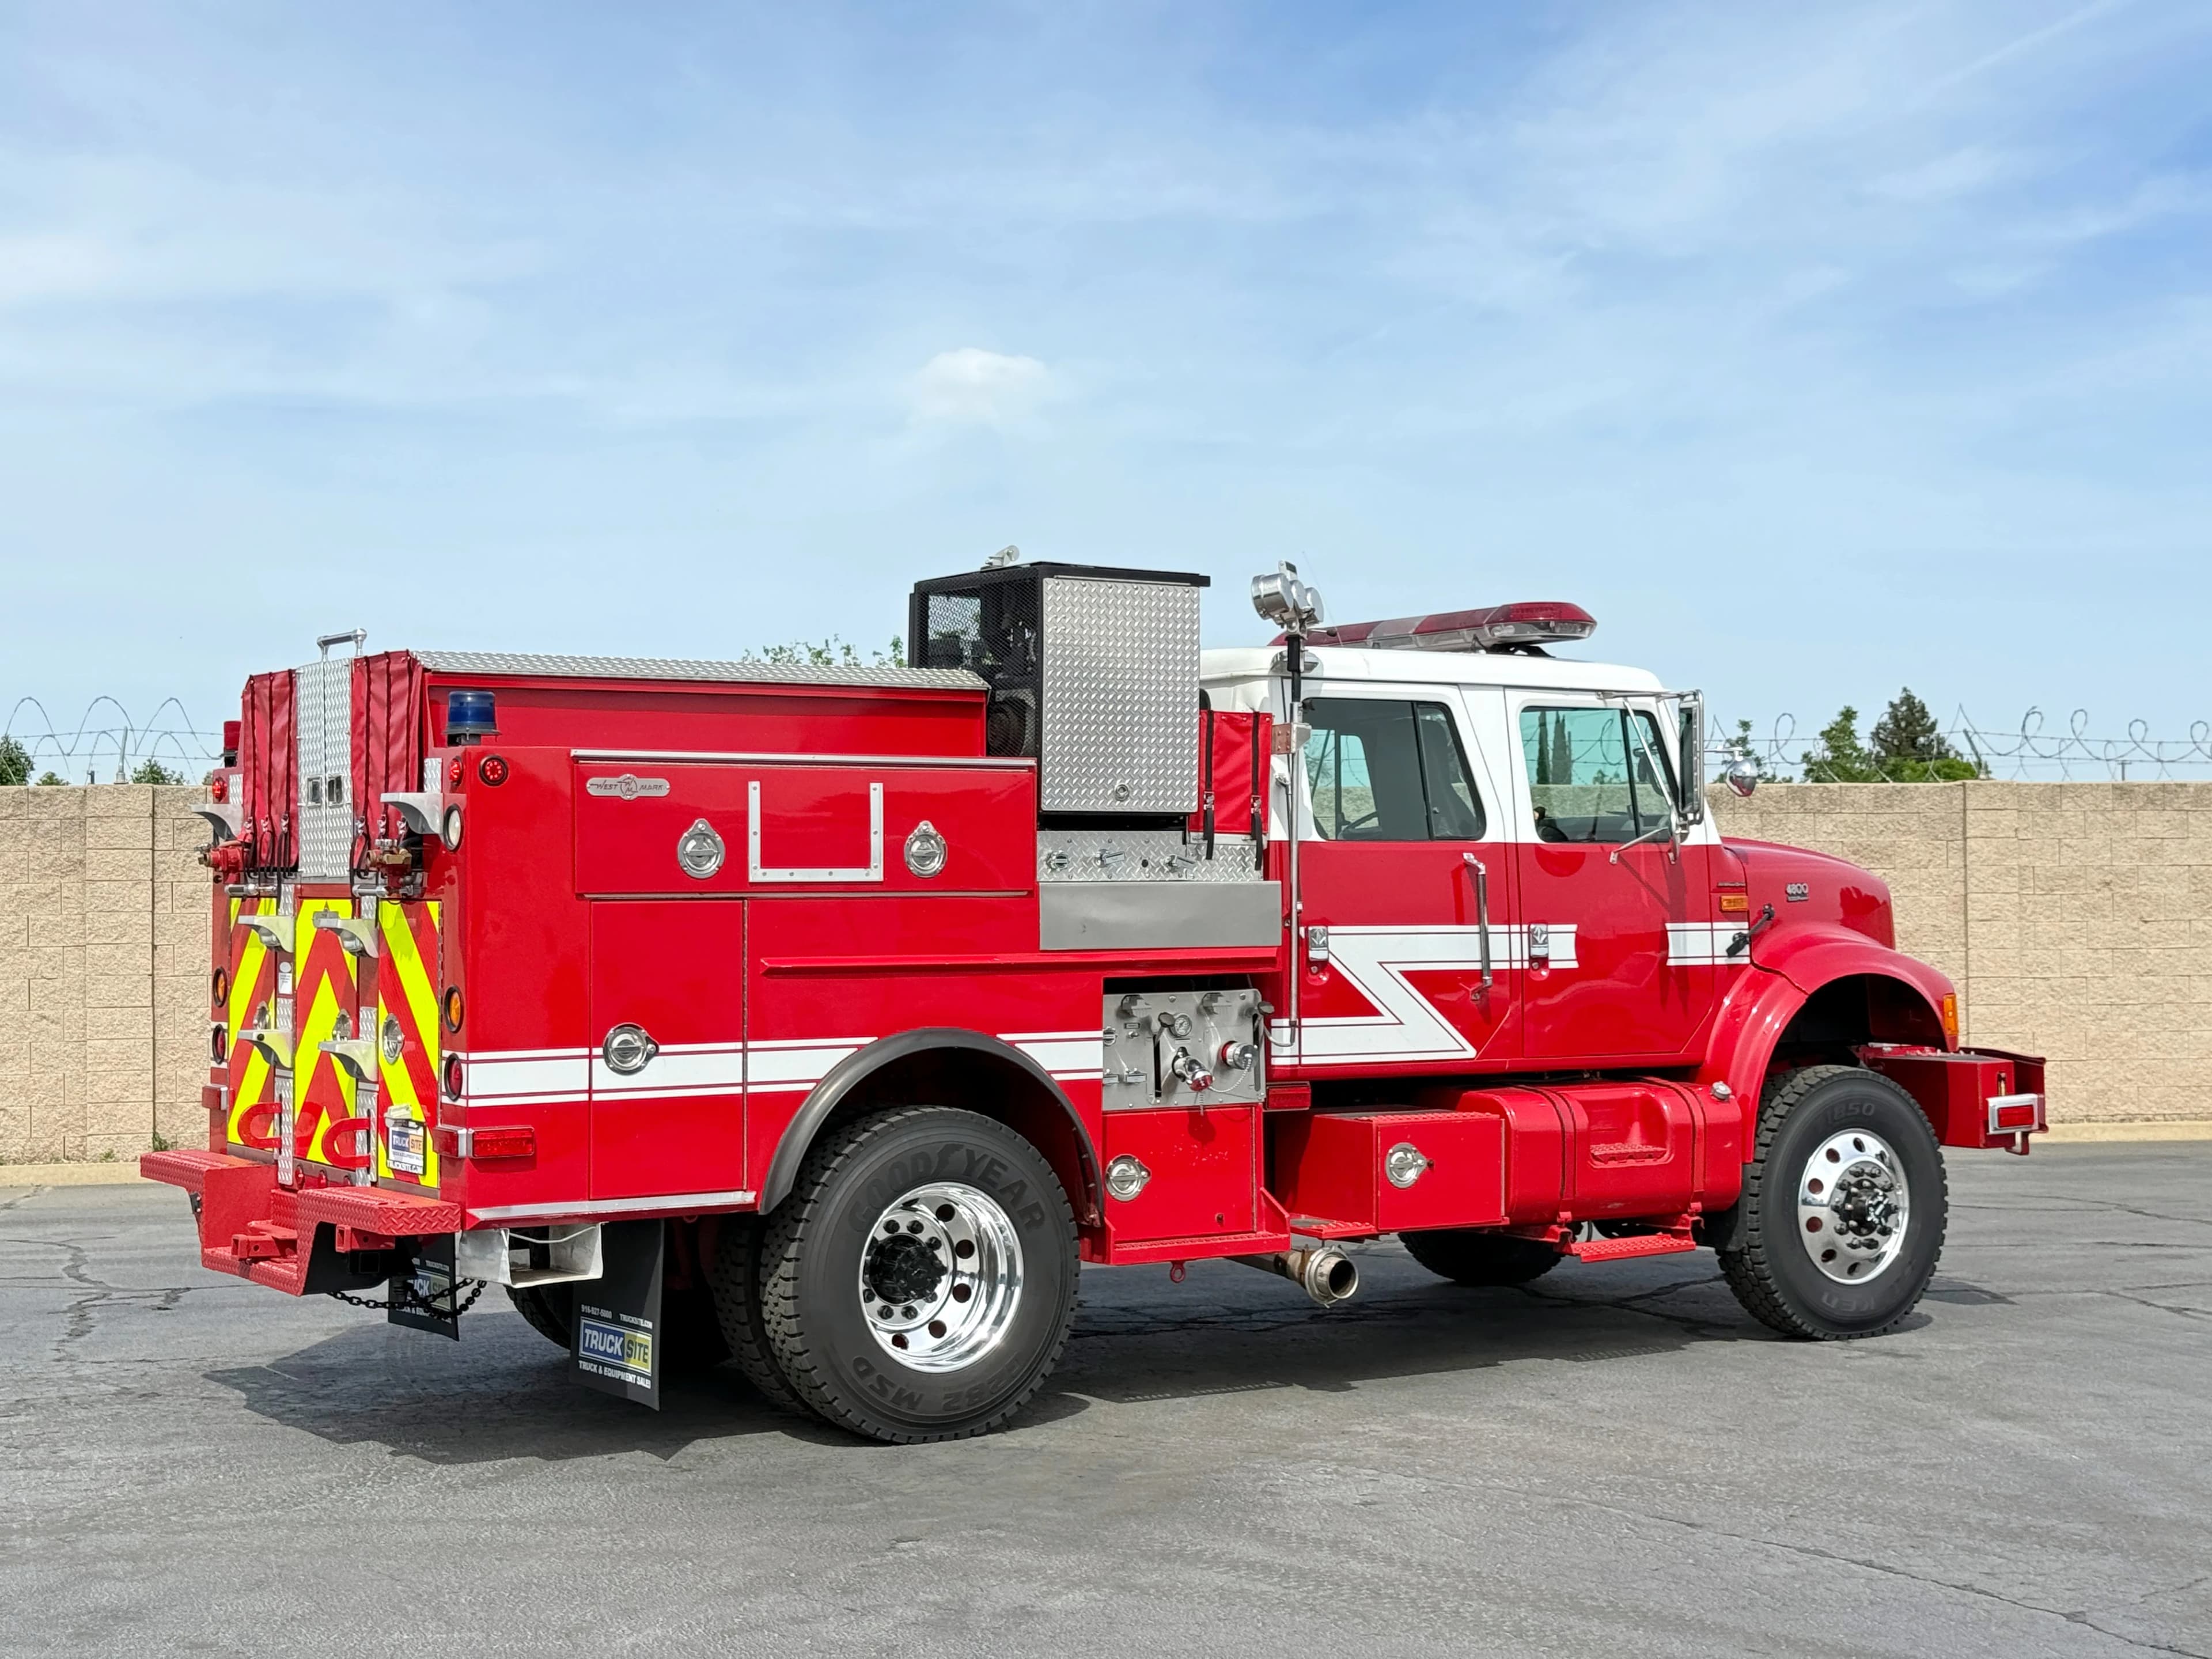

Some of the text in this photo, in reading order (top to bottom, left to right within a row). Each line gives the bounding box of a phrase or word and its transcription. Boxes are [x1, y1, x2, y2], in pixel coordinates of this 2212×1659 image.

[590, 779, 618, 790] WEST
[393, 1134, 422, 1150] TRUCK SITE
[848, 1144, 1045, 1232] GOODYEAR
[585, 1328, 649, 1364] TRUCK SITE
[578, 1360, 652, 1389] TRUCK & EQUIPMENT SALES
[853, 1357, 924, 1411] MSD
